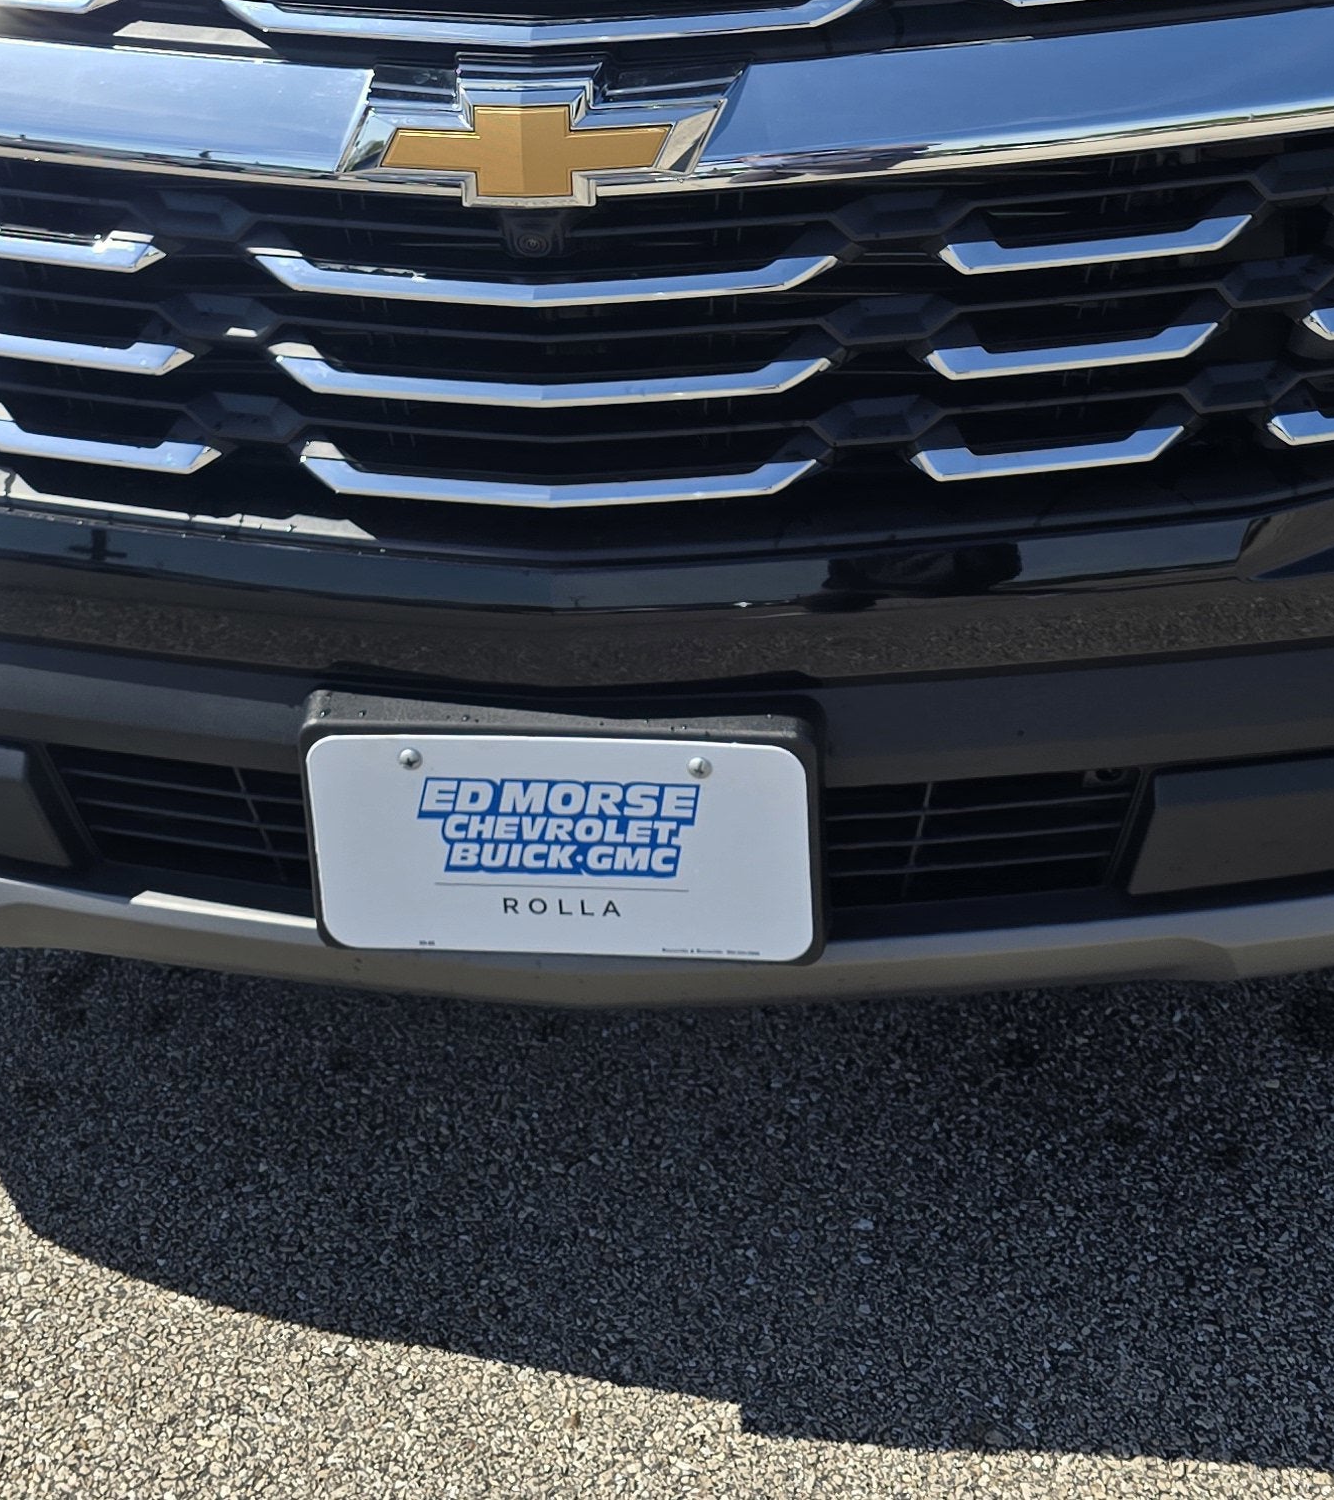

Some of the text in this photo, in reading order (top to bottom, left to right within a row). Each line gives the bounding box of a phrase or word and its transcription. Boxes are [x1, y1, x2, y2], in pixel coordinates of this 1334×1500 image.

[420, 779, 699, 819] ED MORSE
[443, 814, 678, 845] CHEVROLET
[503, 897, 621, 917] ROLLA
